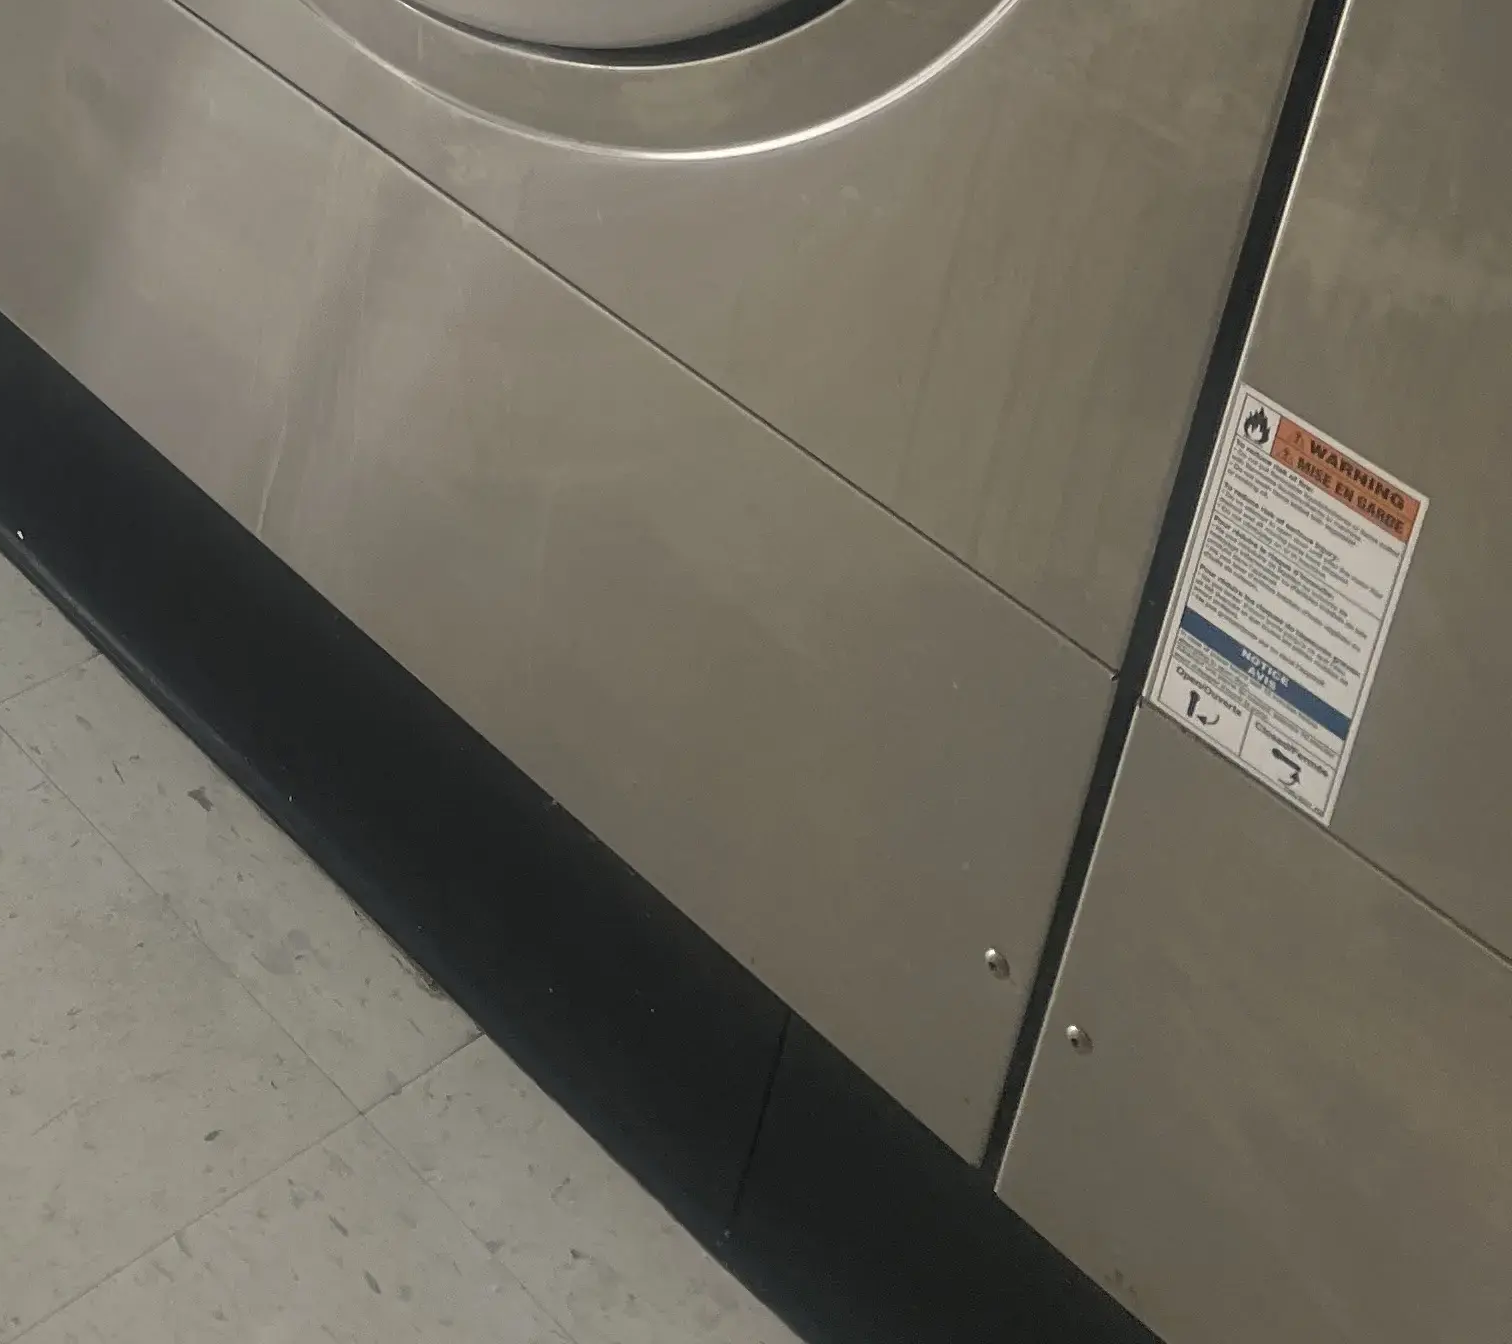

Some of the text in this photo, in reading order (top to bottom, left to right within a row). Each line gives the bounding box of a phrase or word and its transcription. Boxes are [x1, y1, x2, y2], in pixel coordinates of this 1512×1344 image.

[1296, 456, 1405, 535] MISE EN GARDE
[1310, 439, 1405, 511] WARNING
[1240, 648, 1289, 688] NOTICE
[1248, 667, 1277, 691] AVIS
